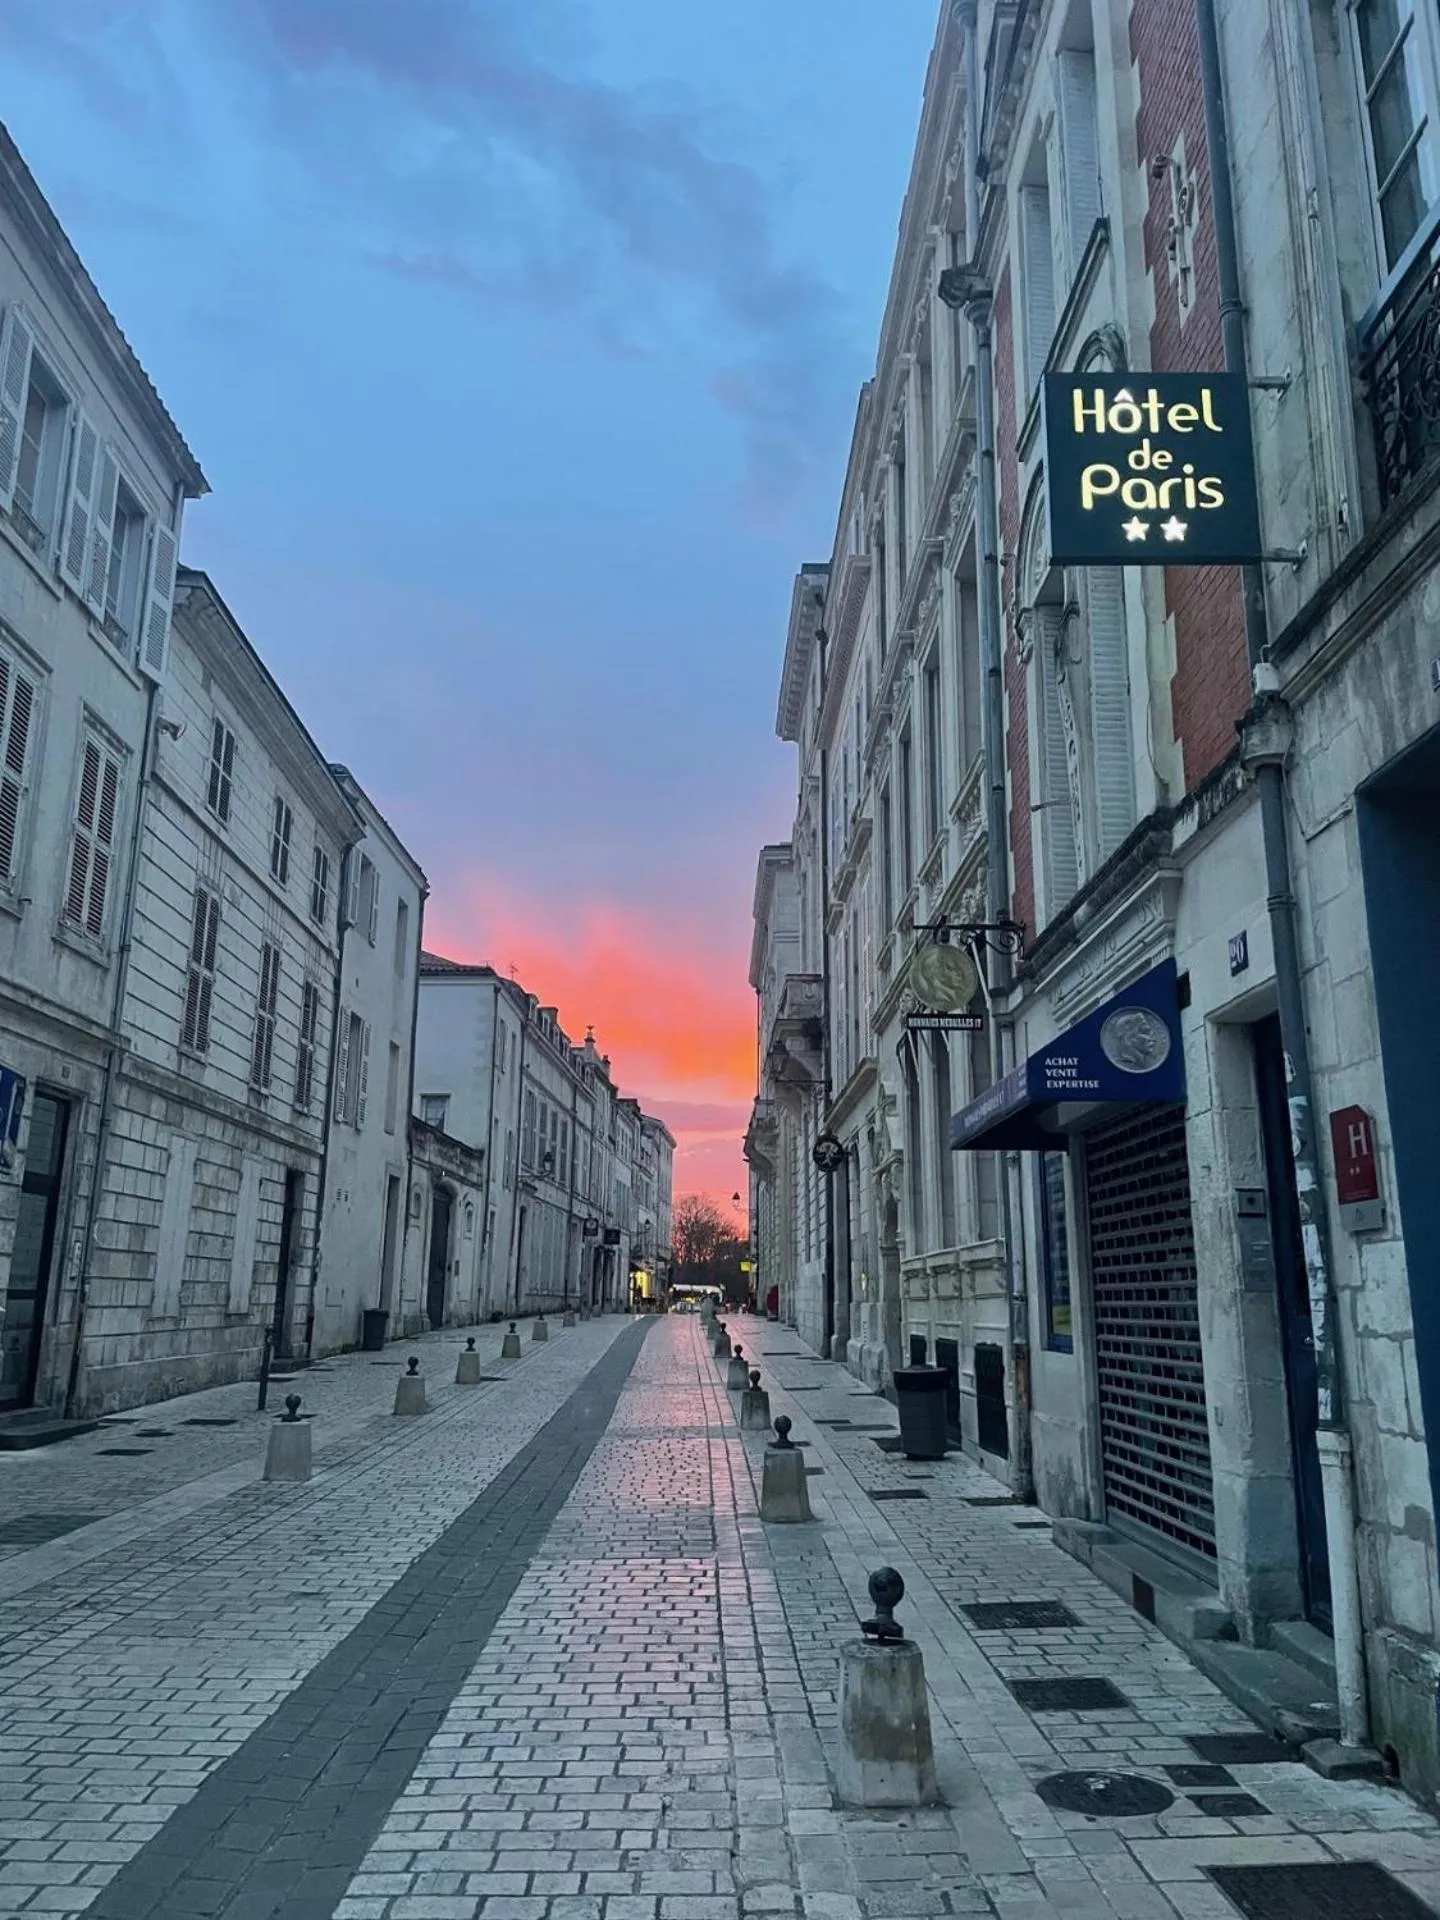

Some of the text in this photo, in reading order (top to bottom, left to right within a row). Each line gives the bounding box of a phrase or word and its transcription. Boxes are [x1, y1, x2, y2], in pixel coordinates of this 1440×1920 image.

[1072, 388, 1224, 434] Hôtel
[1128, 438, 1174, 471] de
[1081, 463, 1225, 511] Paris
[1045, 1057, 1079, 1066] ACHAT
[1045, 1068, 1078, 1077] VENTE
[1046, 1079, 1099, 1089] EXPERTISE
[1348, 1121, 1369, 1159] H
